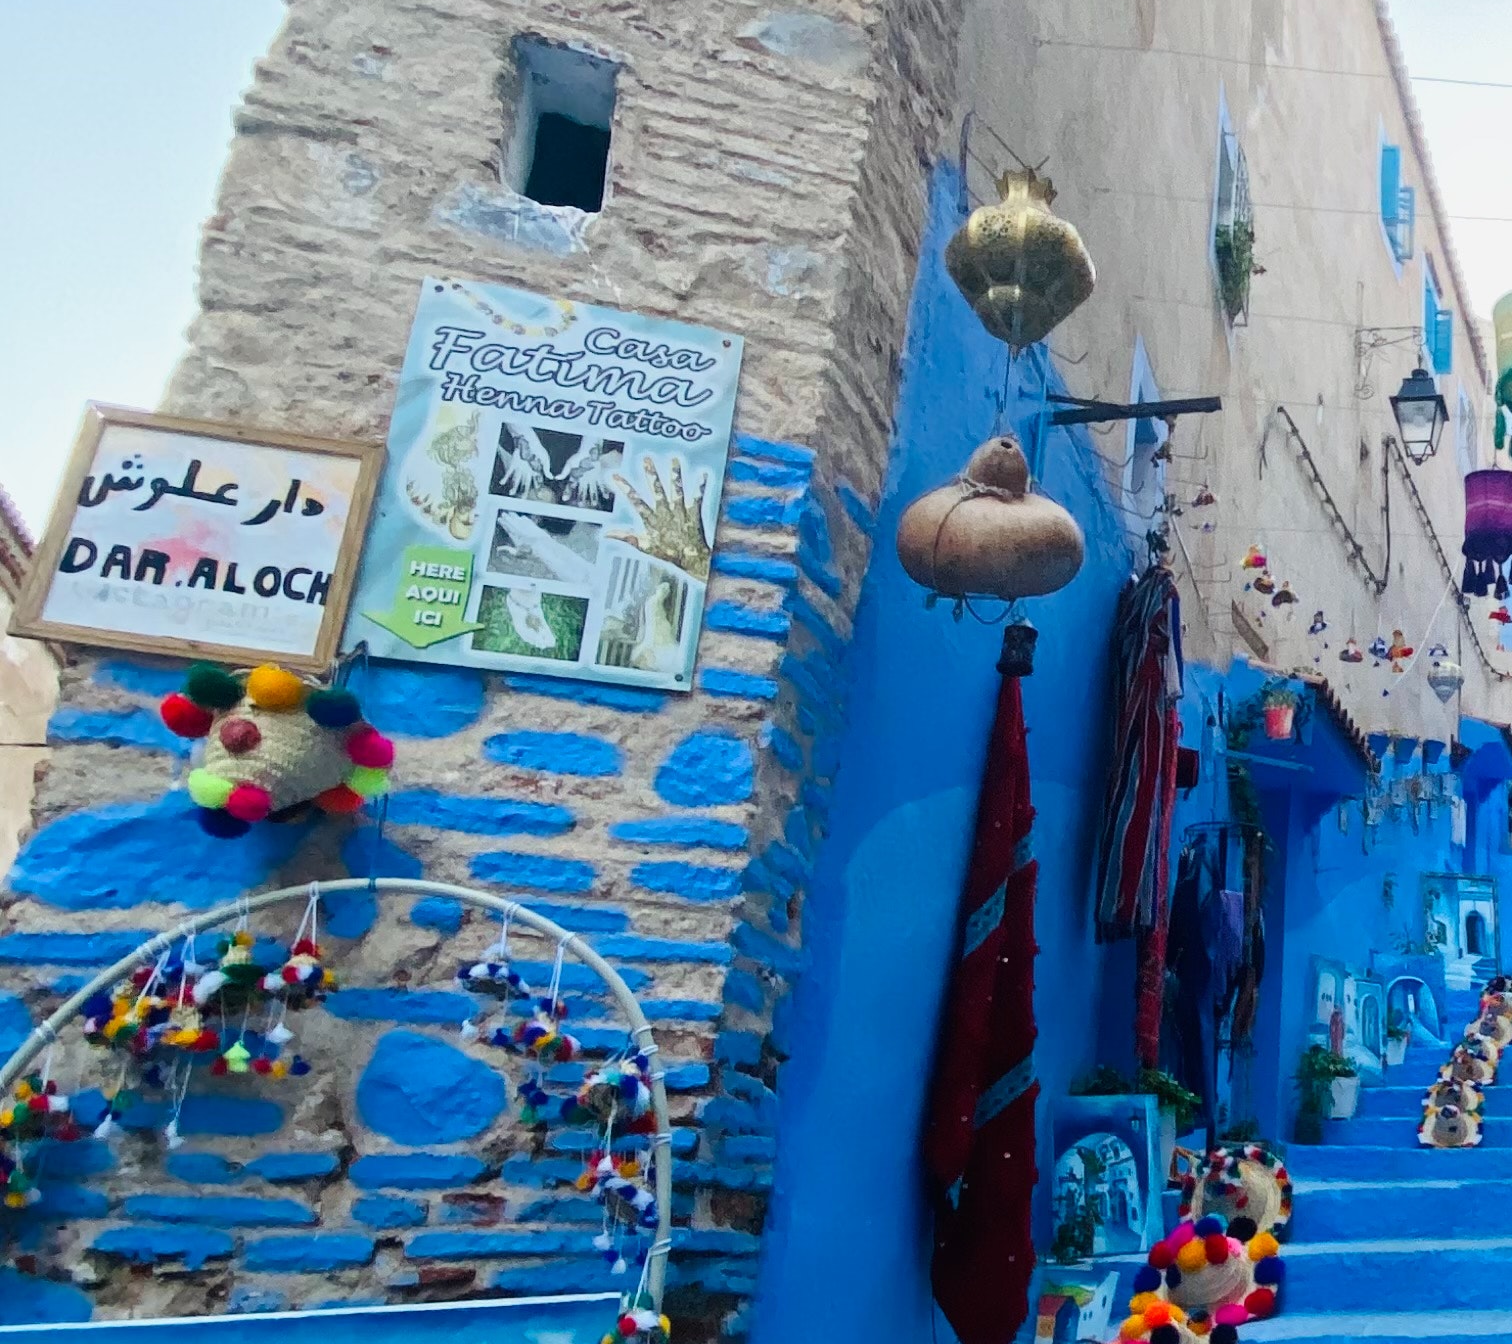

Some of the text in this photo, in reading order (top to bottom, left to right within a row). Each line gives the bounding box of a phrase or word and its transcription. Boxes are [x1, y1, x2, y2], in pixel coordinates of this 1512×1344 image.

[584, 327, 716, 372] Casa
[441, 372, 712, 441] Henna Tattoo
[77, 454, 325, 525] دار علوش
[410, 560, 466, 582] HERE
[406, 584, 461, 605] AQUI
[414, 610, 443, 627] ICI
